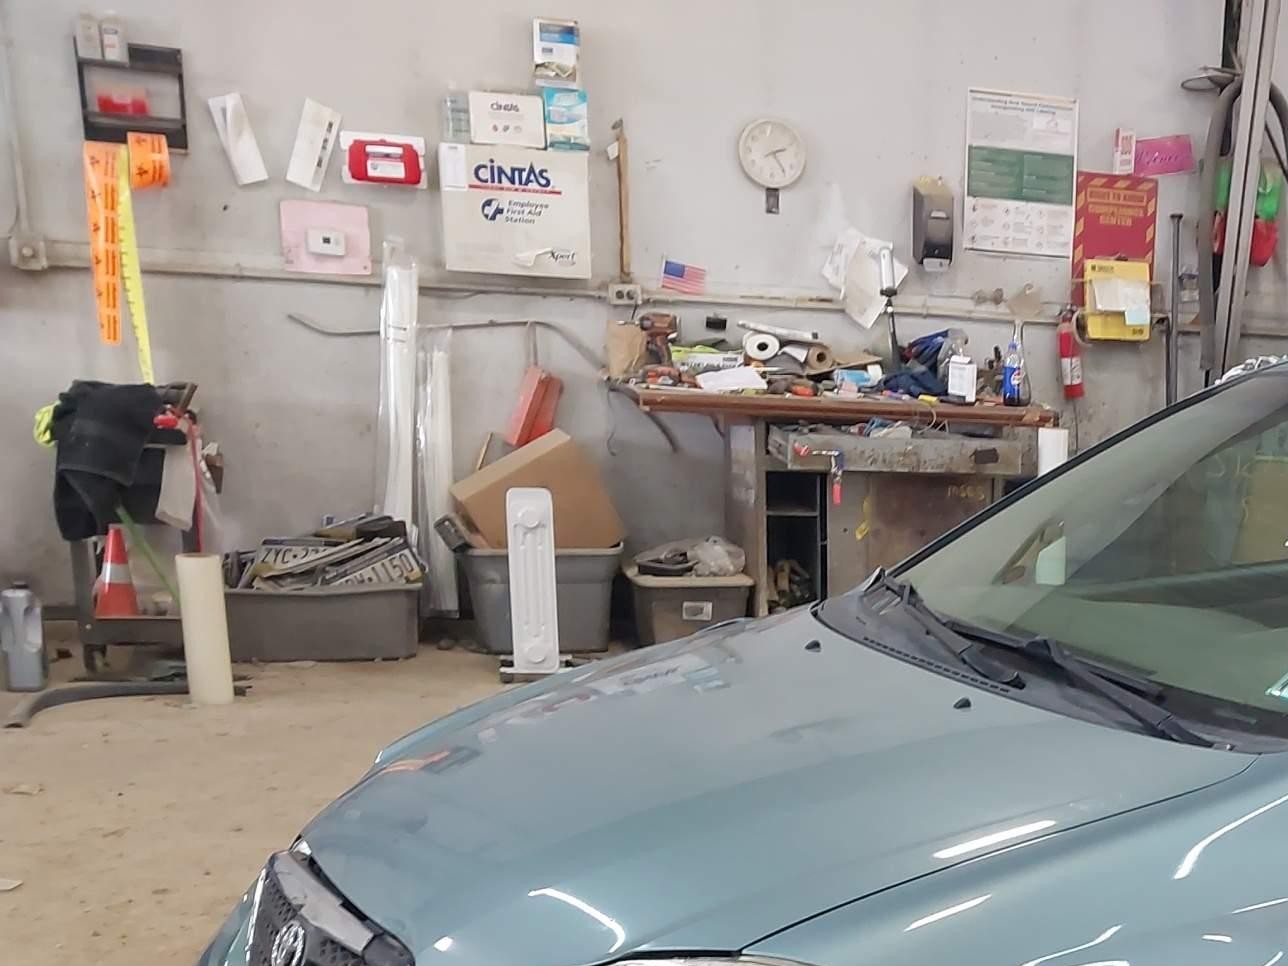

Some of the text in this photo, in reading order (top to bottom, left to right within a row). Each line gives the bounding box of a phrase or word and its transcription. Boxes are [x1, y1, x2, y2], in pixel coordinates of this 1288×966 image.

[473, 158, 552, 188] CINTAS
[508, 200, 549, 209] Employee
[507, 208, 525, 216] First
